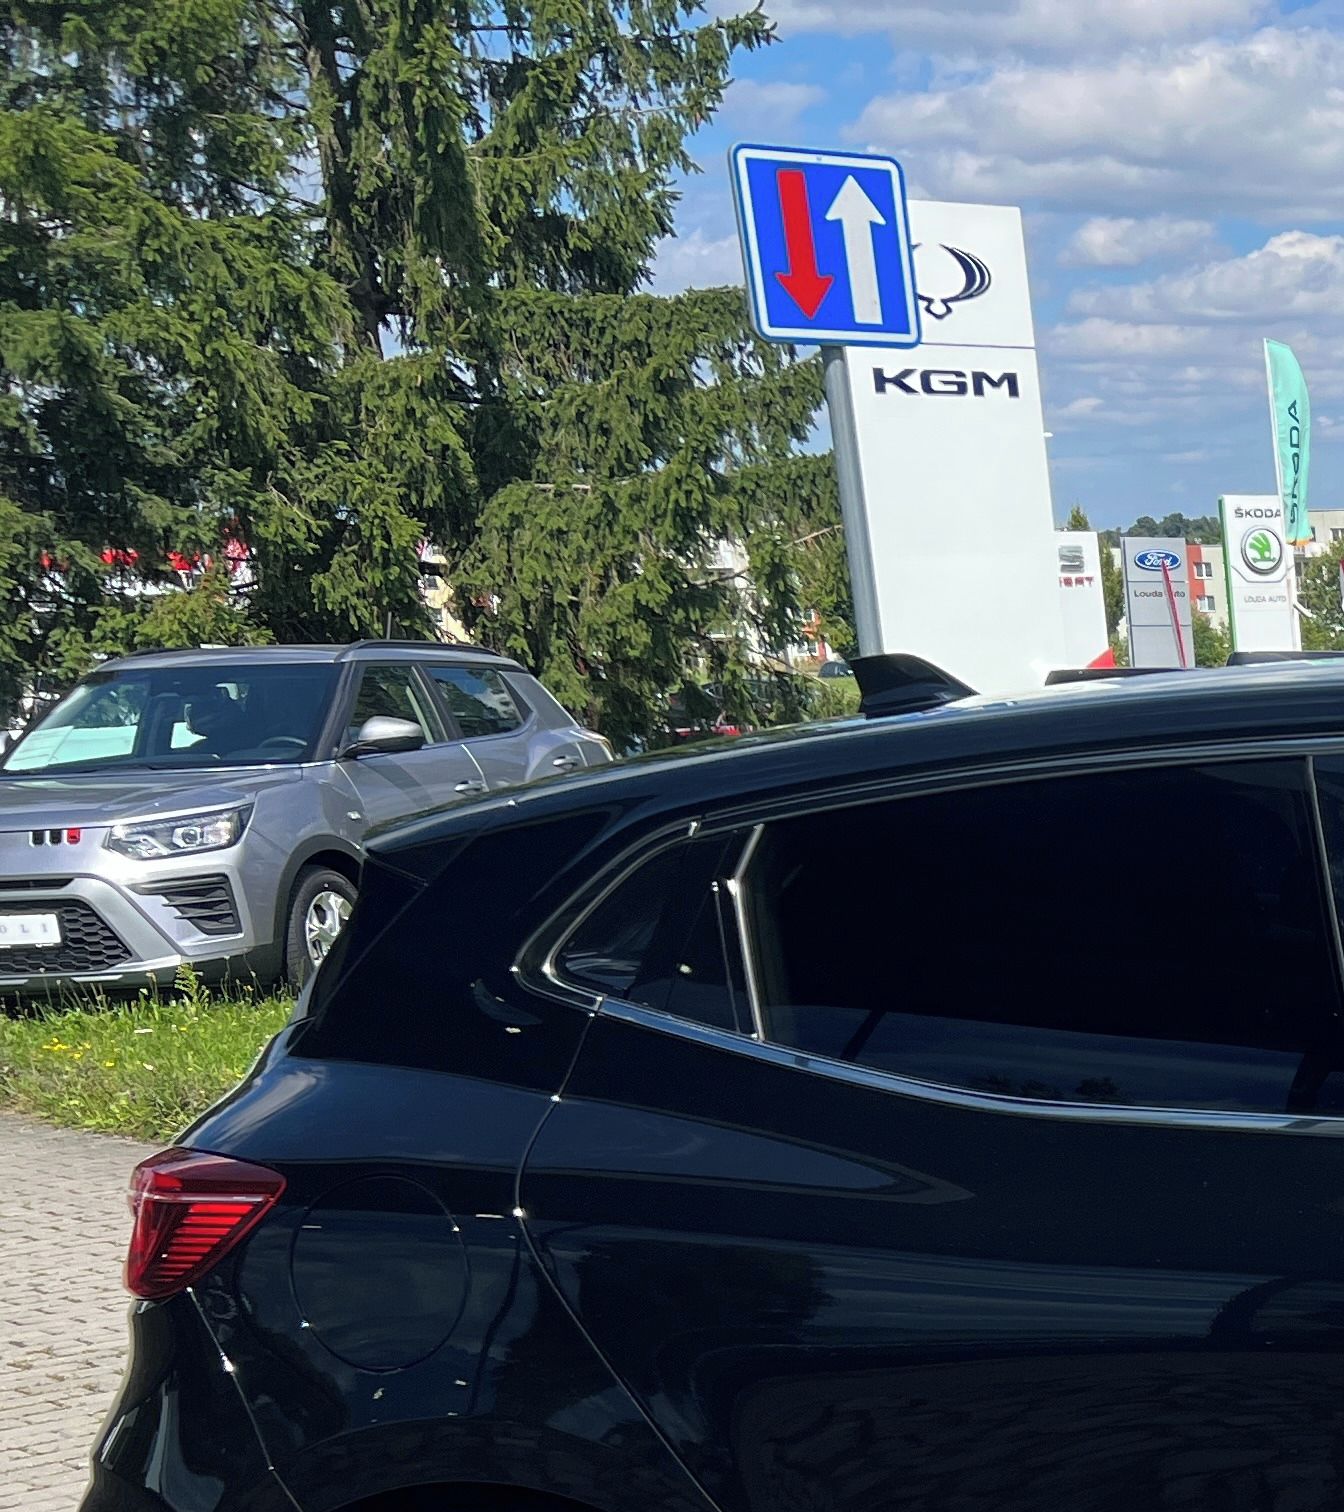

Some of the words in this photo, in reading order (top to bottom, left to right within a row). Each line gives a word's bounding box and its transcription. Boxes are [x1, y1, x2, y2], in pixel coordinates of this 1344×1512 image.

[872, 367, 1019, 398] KGM
[1234, 506, 1281, 518] ŠKODA
[1059, 576, 1094, 588] EAT
[1134, 590, 1163, 598] Louda
